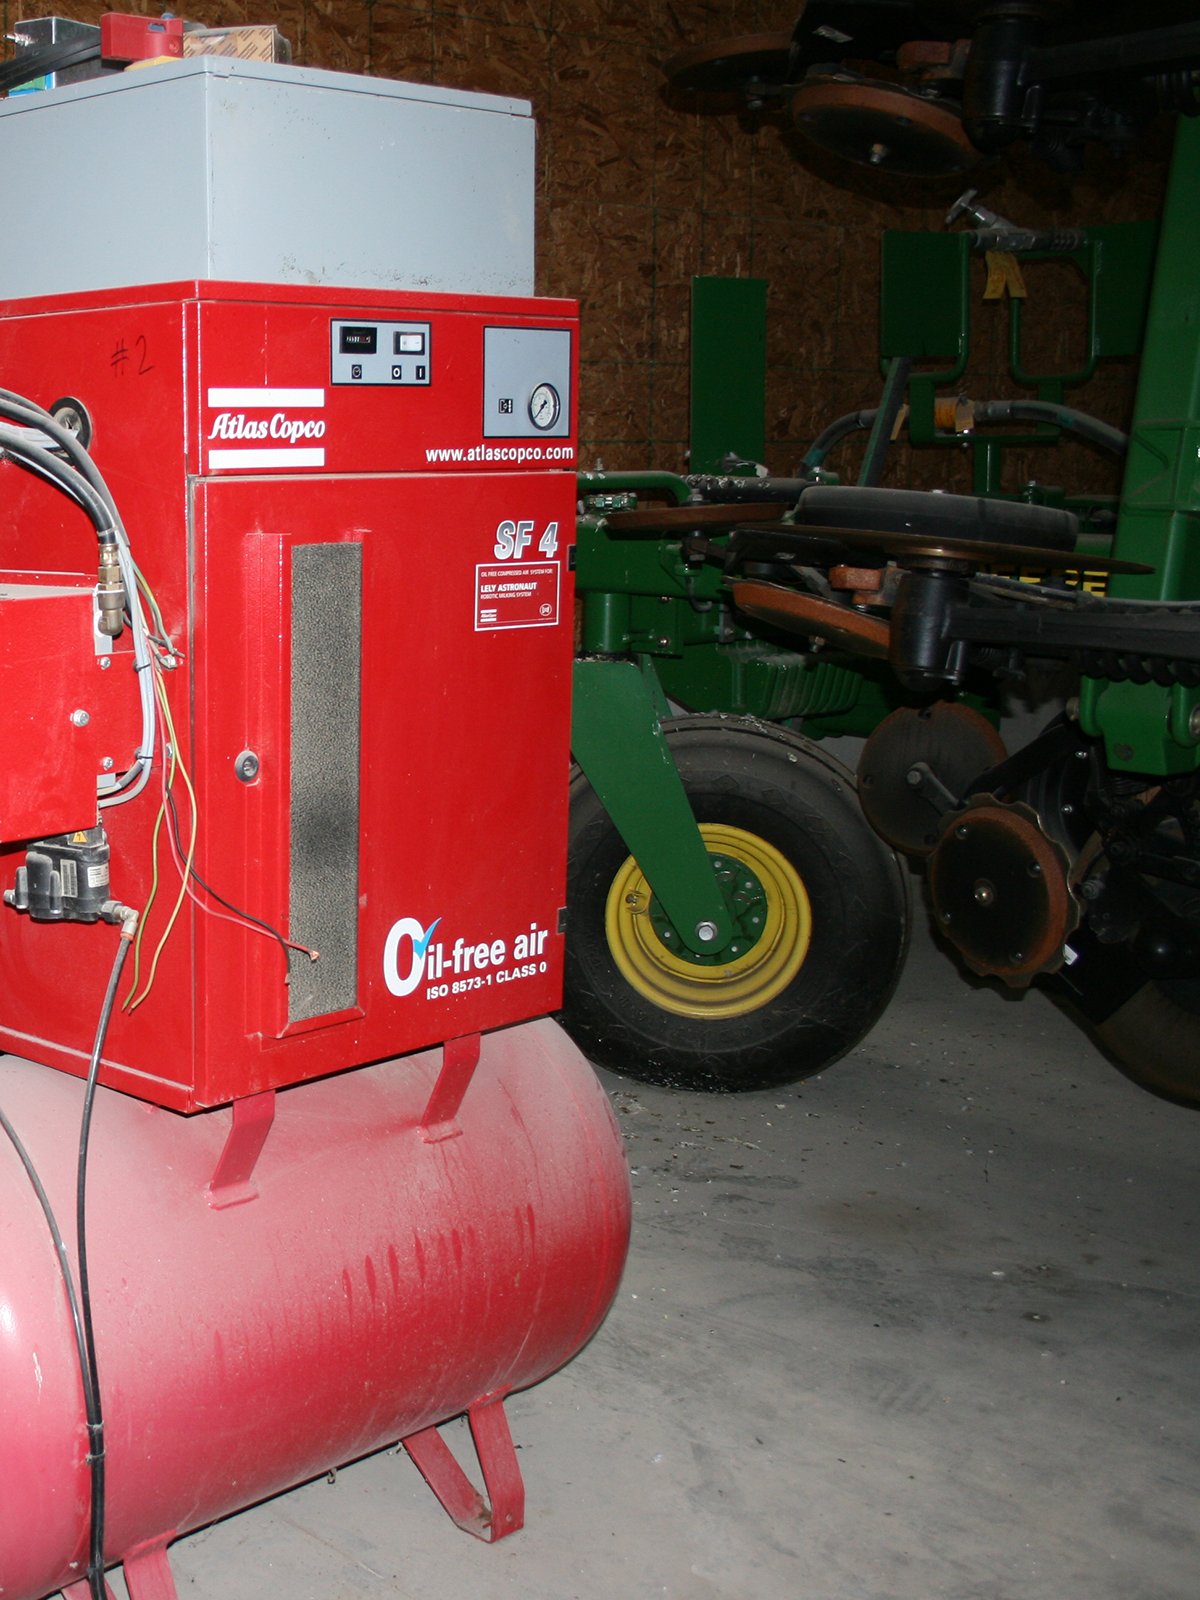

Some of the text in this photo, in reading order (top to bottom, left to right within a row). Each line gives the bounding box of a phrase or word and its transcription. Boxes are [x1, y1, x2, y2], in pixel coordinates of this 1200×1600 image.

[208, 413, 326, 444] Atlas Copco
[425, 444, 574, 464] www.atlascopco.com
[494, 520, 558, 560] SF 4
[480, 582, 538, 593] LELY ASTRONAUT
[513, 923, 549, 960] air
[426, 984, 449, 1000] ISO
[451, 974, 492, 994] 8573-1
[495, 963, 537, 984] CLASS
